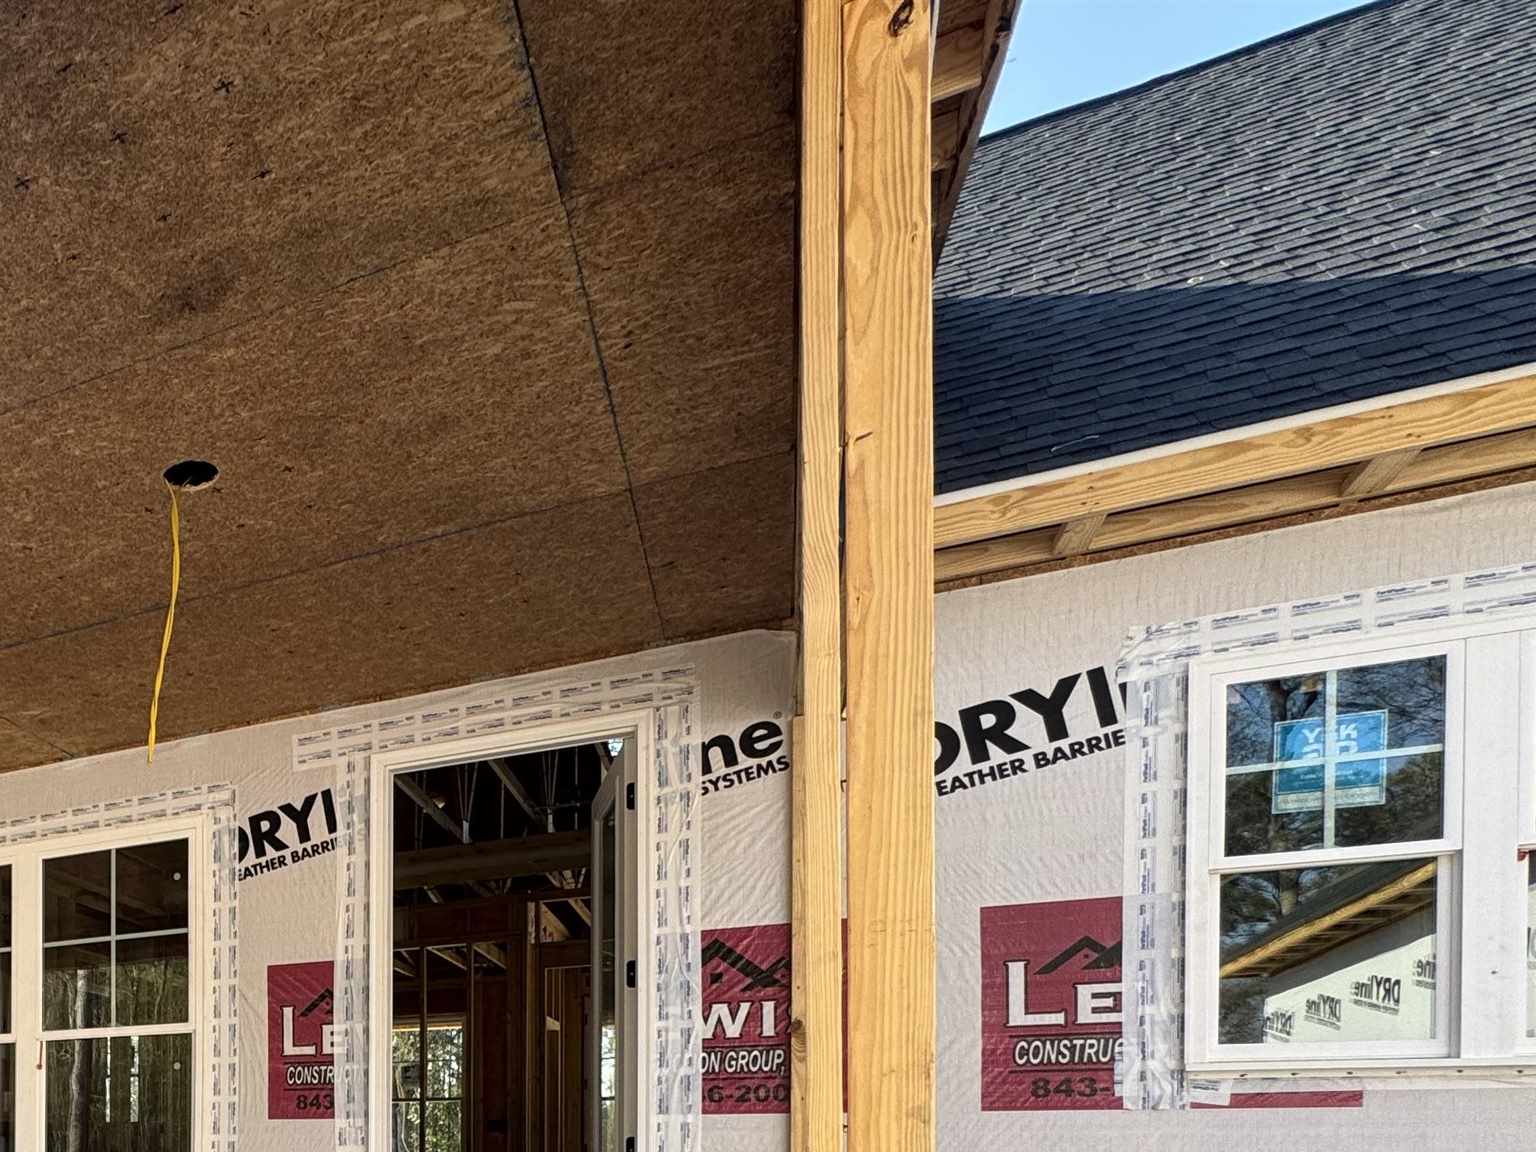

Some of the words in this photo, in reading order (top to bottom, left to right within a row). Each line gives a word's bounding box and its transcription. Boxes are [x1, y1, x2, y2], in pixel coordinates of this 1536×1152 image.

[935, 758, 1029, 797] EATHER
[1032, 728, 1127, 770] BARRIE
[724, 1050, 785, 1077] GROUP,
